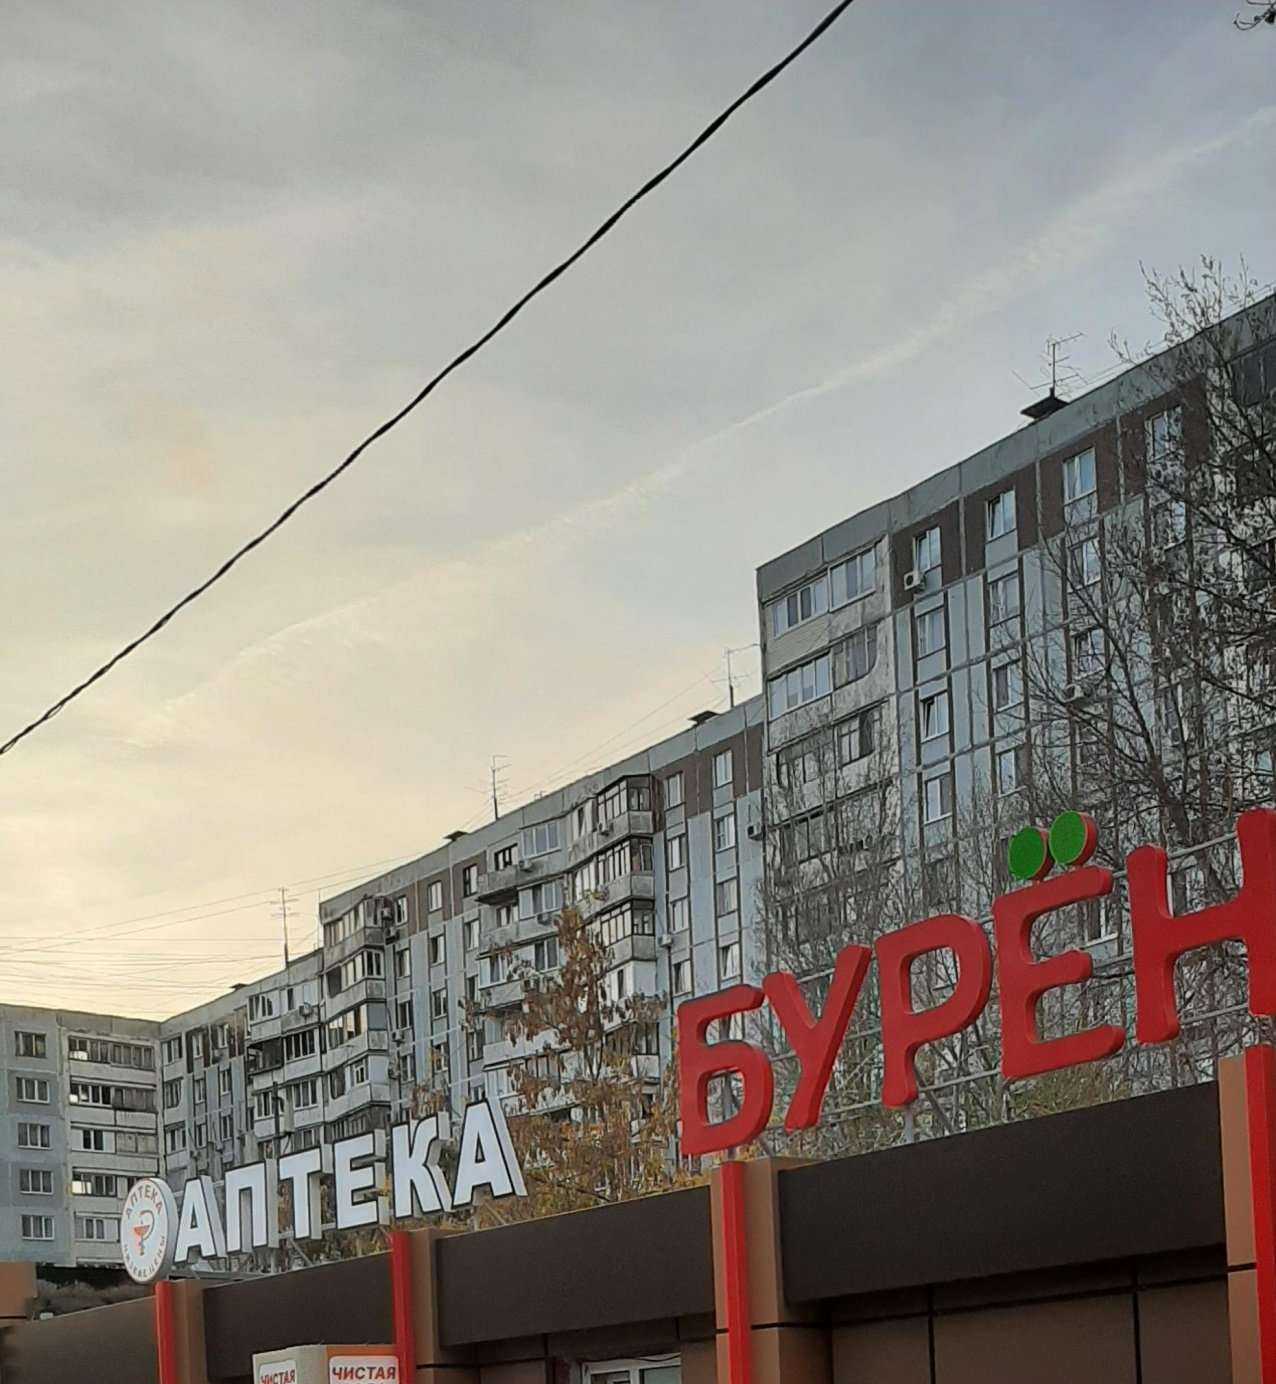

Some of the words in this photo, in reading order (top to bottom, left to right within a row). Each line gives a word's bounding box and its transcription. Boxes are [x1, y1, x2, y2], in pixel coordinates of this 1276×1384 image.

[677, 808, 1276, 1157] БУРЁН
[125, 1183, 163, 1219] АПТЕКА
[174, 1099, 527, 1264] АПТЕКА
[331, 1366, 396, 1381] ЧИСТАЯ
